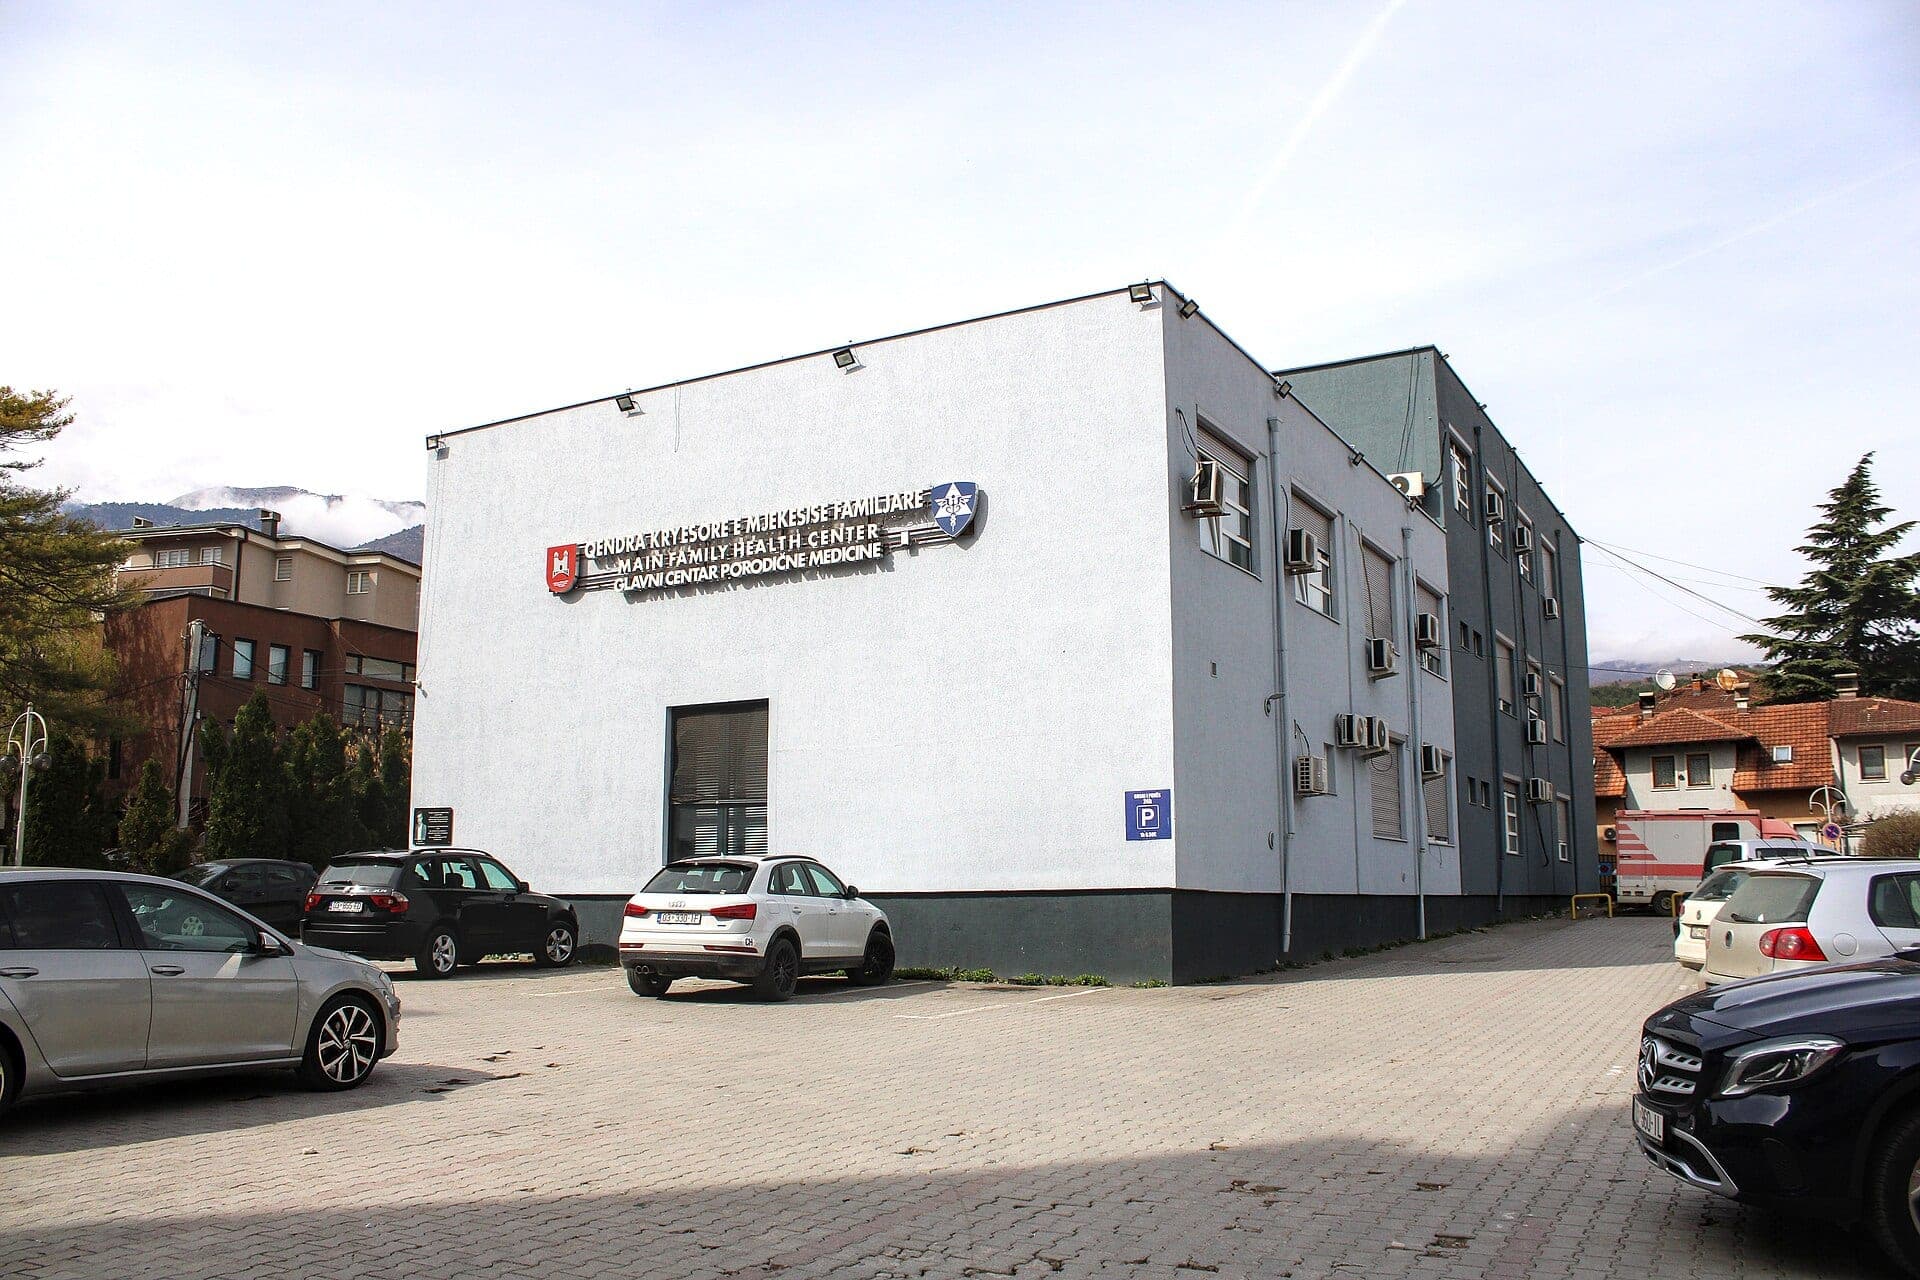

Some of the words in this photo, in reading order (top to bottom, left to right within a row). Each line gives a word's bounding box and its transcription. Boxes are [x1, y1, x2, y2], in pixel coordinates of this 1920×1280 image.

[584, 533, 645, 559] QENDRA
[650, 521, 729, 549] KRYESORE
[733, 518, 742, 536] E
[745, 503, 828, 534] MJEKESISE
[833, 489, 924, 520] FAMILJARE
[618, 553, 664, 574] MAIN
[668, 544, 728, 567] FAMILY
[733, 532, 801, 558] HEALTH
[807, 523, 879, 548] CENTER
[613, 571, 663, 592] GLAVNI
[665, 565, 718, 586] CENTAR
[720, 551, 806, 578] PORODIČNE
[808, 541, 882, 567] MEDICINE
[1141, 807, 1155, 827] P
